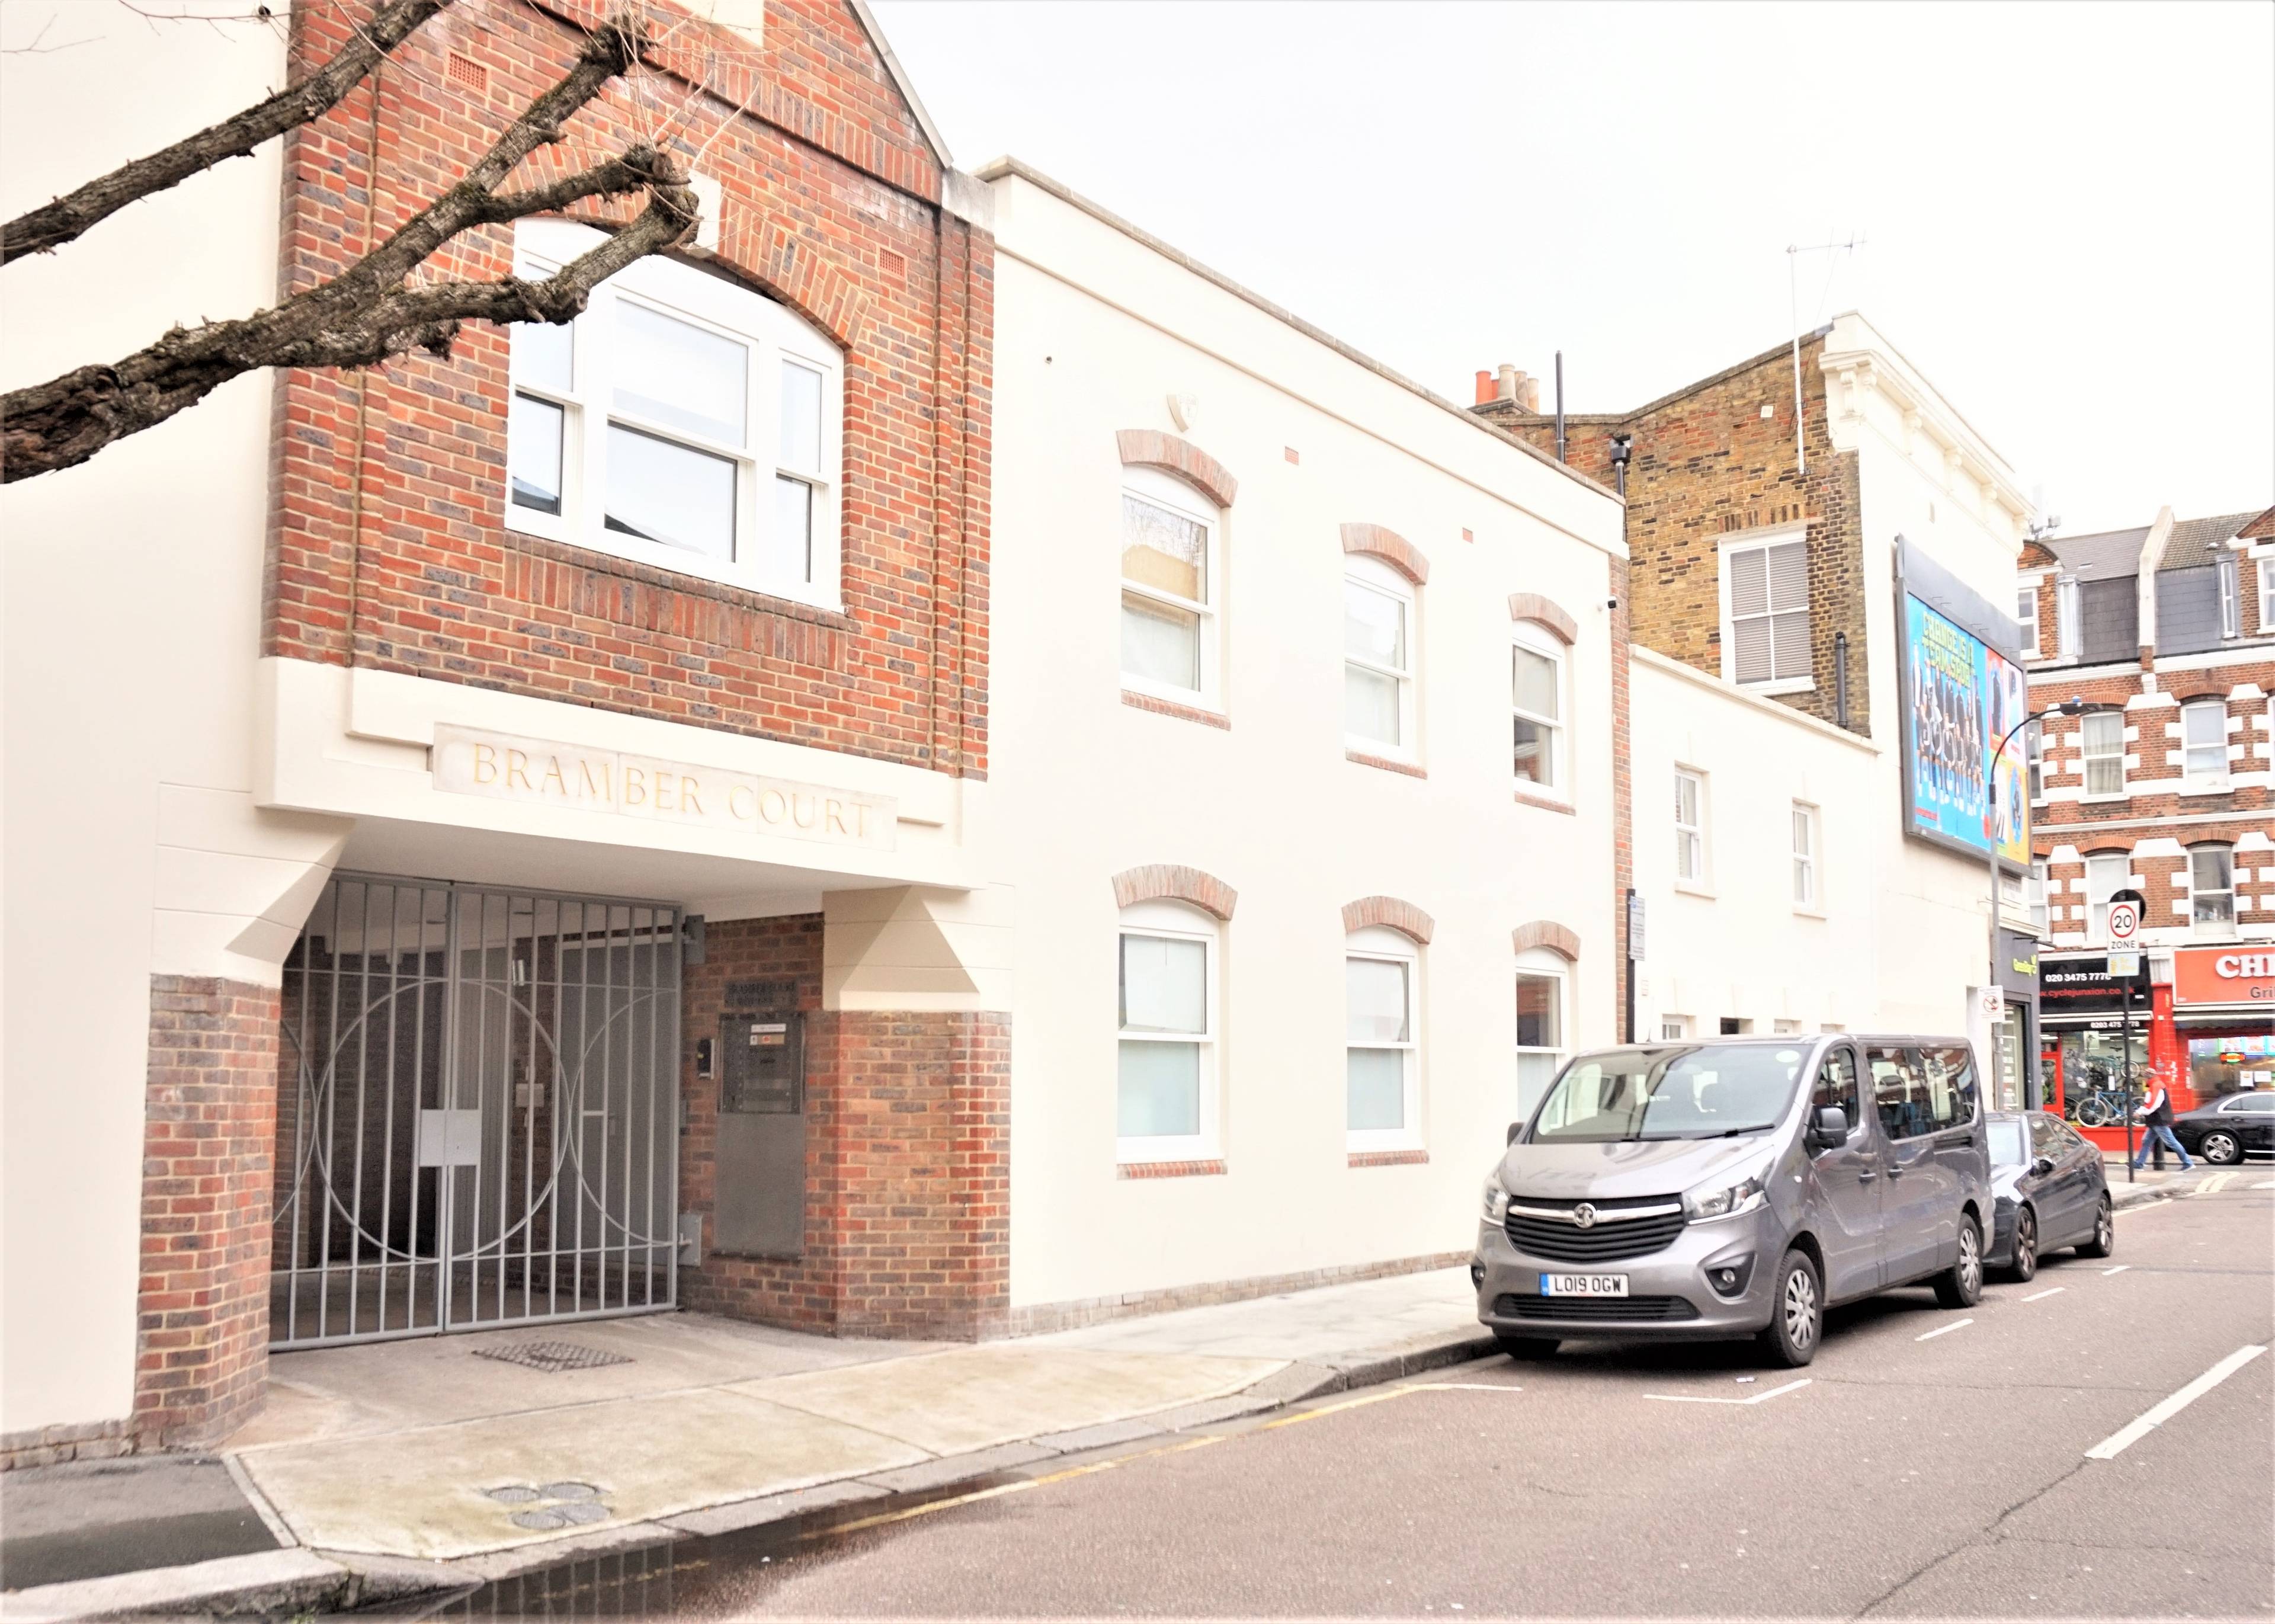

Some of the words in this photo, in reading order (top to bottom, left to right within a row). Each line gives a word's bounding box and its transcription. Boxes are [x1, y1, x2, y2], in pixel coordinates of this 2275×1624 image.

[473, 743, 703, 815] BRAMBER
[729, 785, 872, 837] COURT
[2114, 914, 2132, 928] 20
[2111, 940, 2136, 949] ZONE
[2045, 974, 2062, 982] 020
[2064, 973, 2087, 982] 3475
[1555, 1276, 1587, 1292] LO19
[1592, 1277, 1621, 1292] OGW
